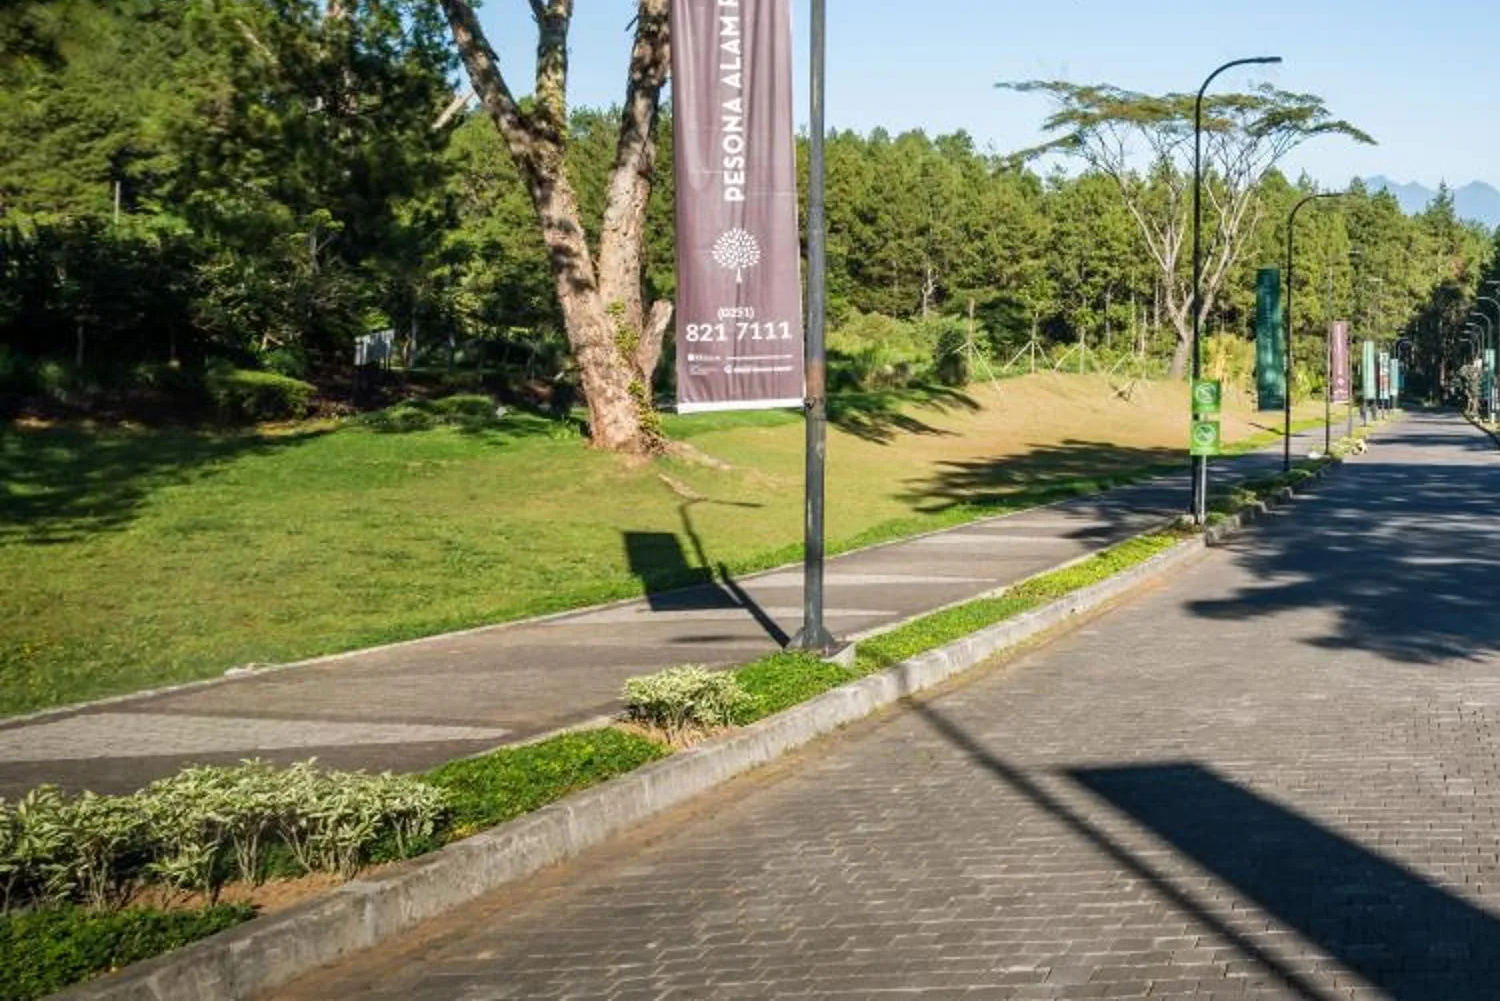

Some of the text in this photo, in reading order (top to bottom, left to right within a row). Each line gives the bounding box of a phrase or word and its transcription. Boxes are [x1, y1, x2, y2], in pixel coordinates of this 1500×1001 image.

[719, 16, 742, 88] ALAM
[721, 97, 746, 202] PESONA
[685, 320, 793, 342] 821 7111
[717, 306, 755, 320] (0251)
